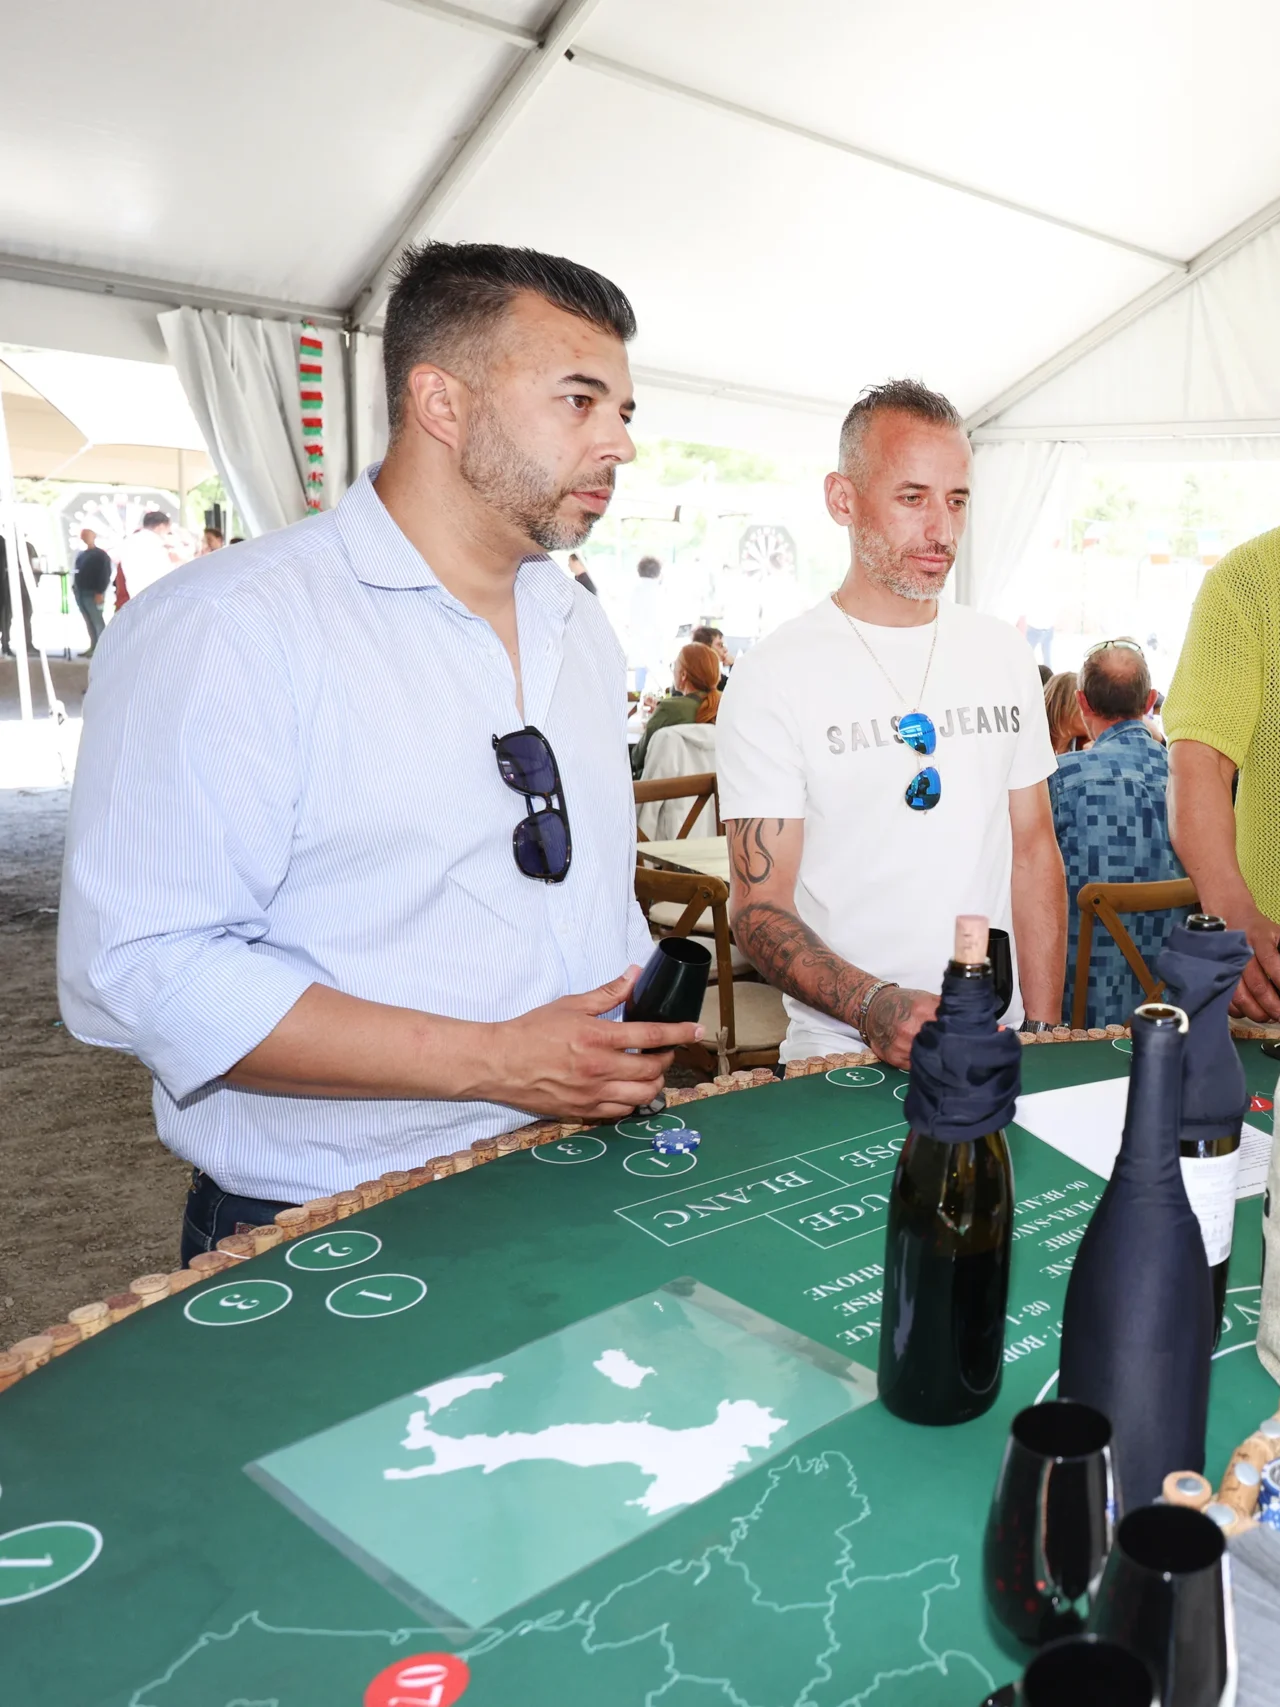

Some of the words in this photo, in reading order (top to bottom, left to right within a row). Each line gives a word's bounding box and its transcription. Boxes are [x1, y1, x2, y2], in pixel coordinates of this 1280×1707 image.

[826, 715, 905, 755] SALS
[939, 705, 1021, 736] JEANS
[845, 1071, 865, 1082] 3
[636, 1118, 663, 1132] 2
[557, 1143, 582, 1155] 3
[840, 1137, 907, 1169] OSÉ
[649, 1156, 673, 1168] 1
[653, 1170, 813, 1229] BLANC
[313, 1242, 353, 1257] 2
[803, 1263, 884, 1301] RHONE
[219, 1293, 260, 1310] 3
[357, 1289, 393, 1302] 1
